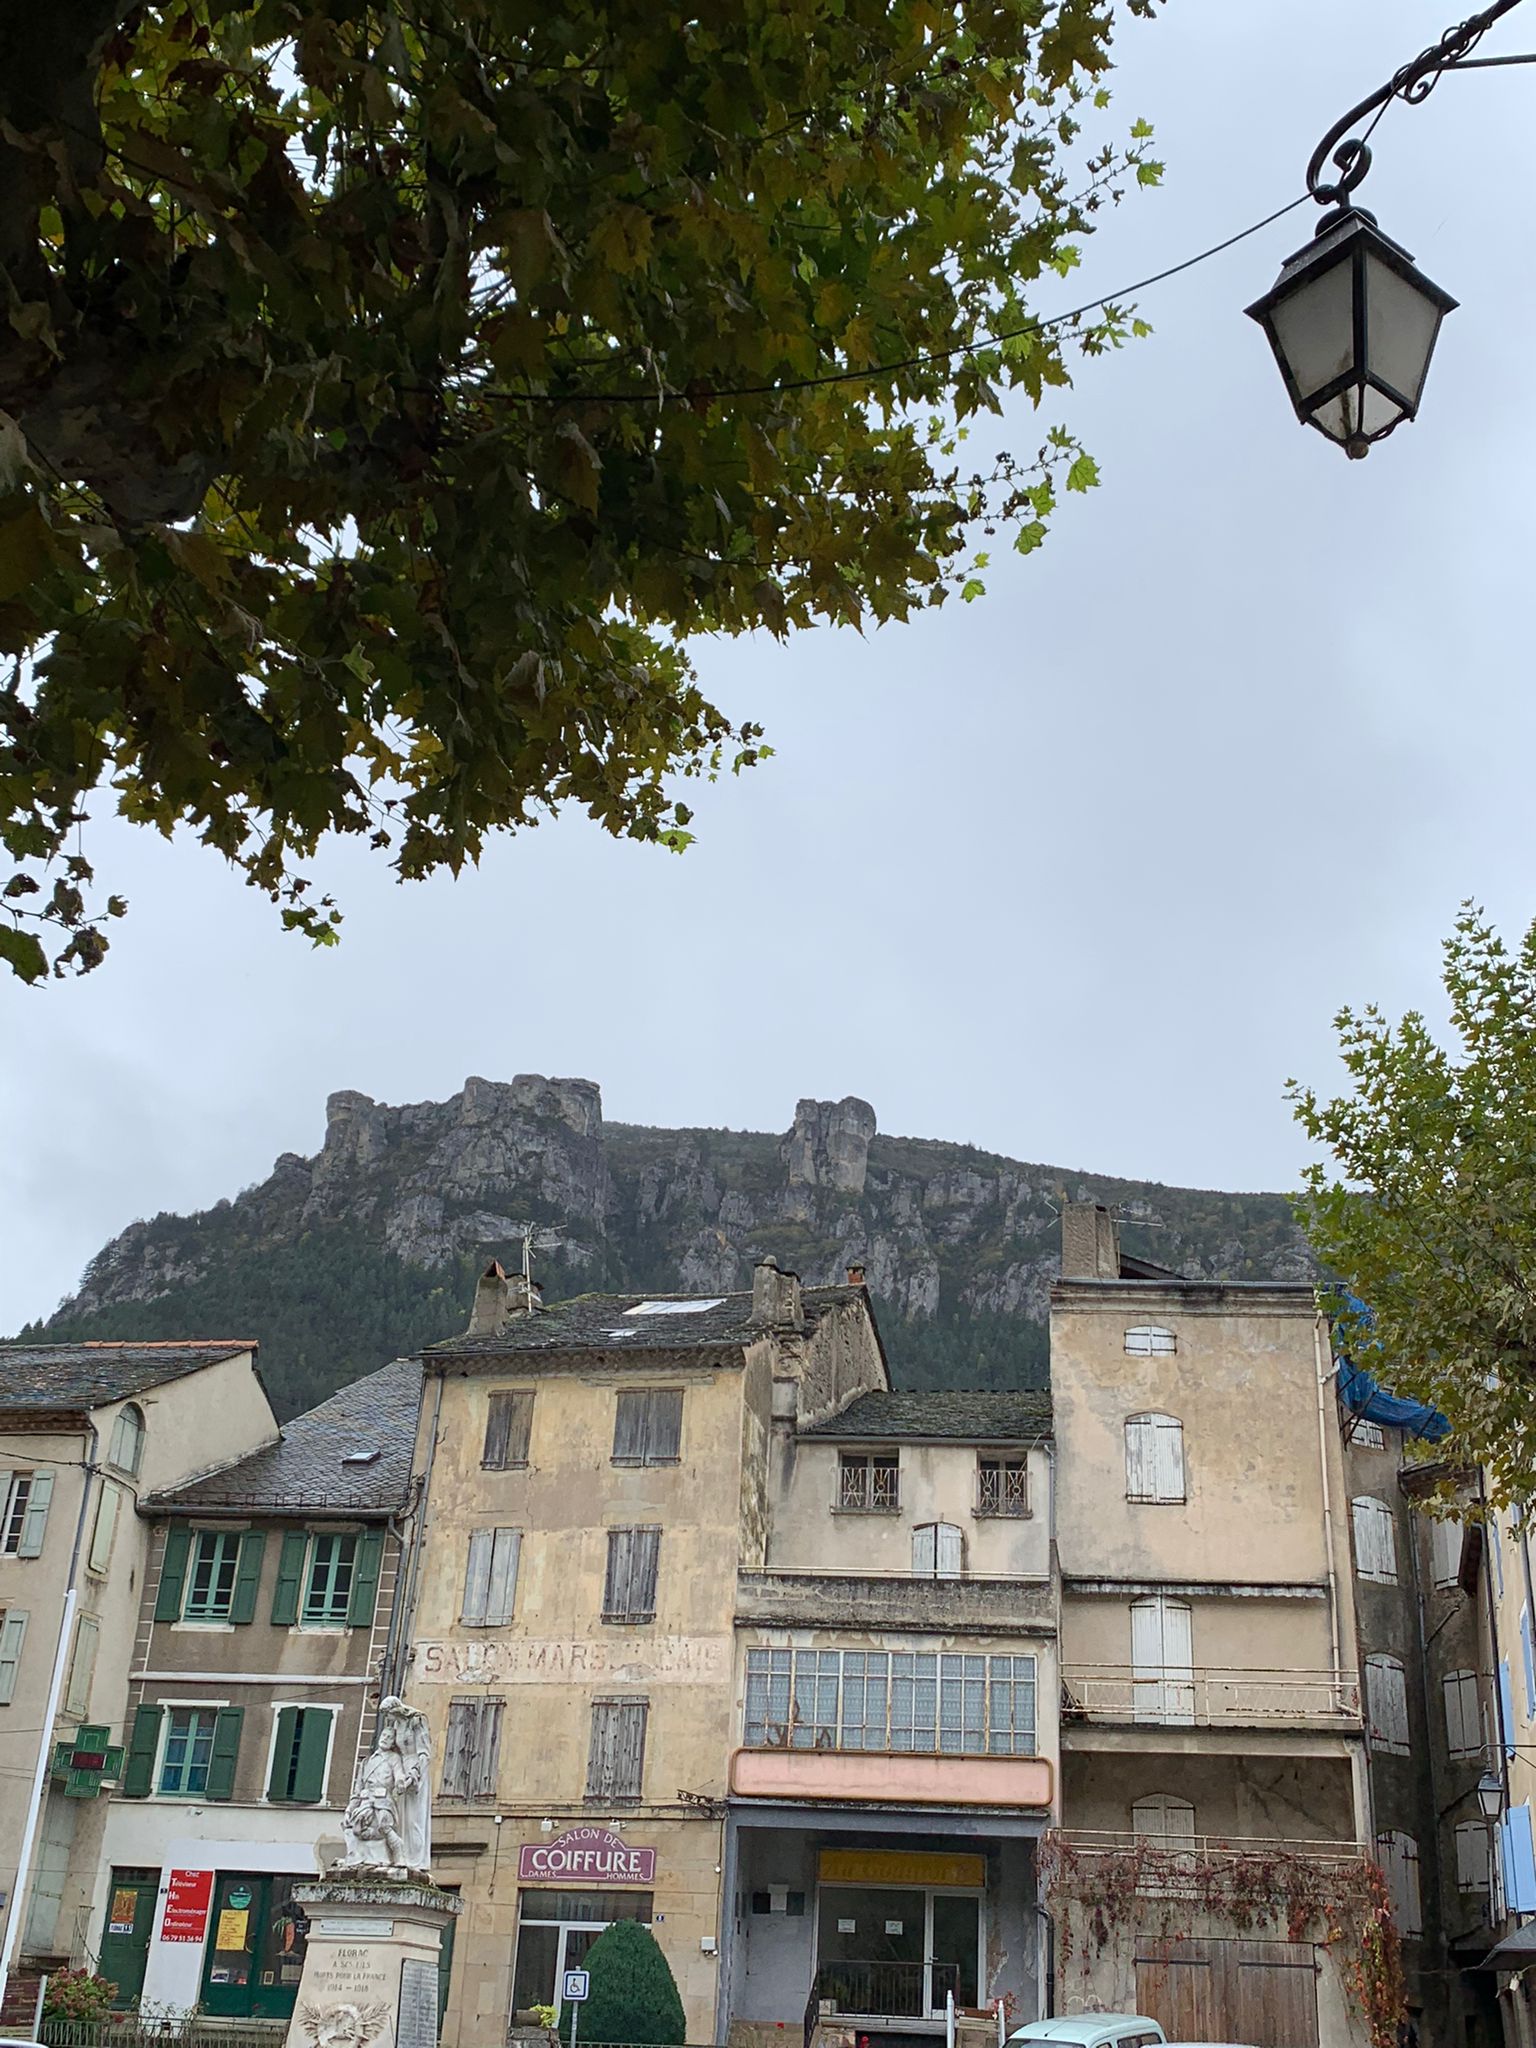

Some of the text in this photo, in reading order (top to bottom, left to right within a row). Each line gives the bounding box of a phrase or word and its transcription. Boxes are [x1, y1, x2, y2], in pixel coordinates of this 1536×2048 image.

[558, 1828, 621, 1849] SALON DE
[531, 1849, 642, 1873] COIFFURE
[528, 1870, 644, 1881] DAMES HOMMES
[337, 1949, 369, 1958] FLORAC
[362, 1973, 386, 1981] FRANCE
